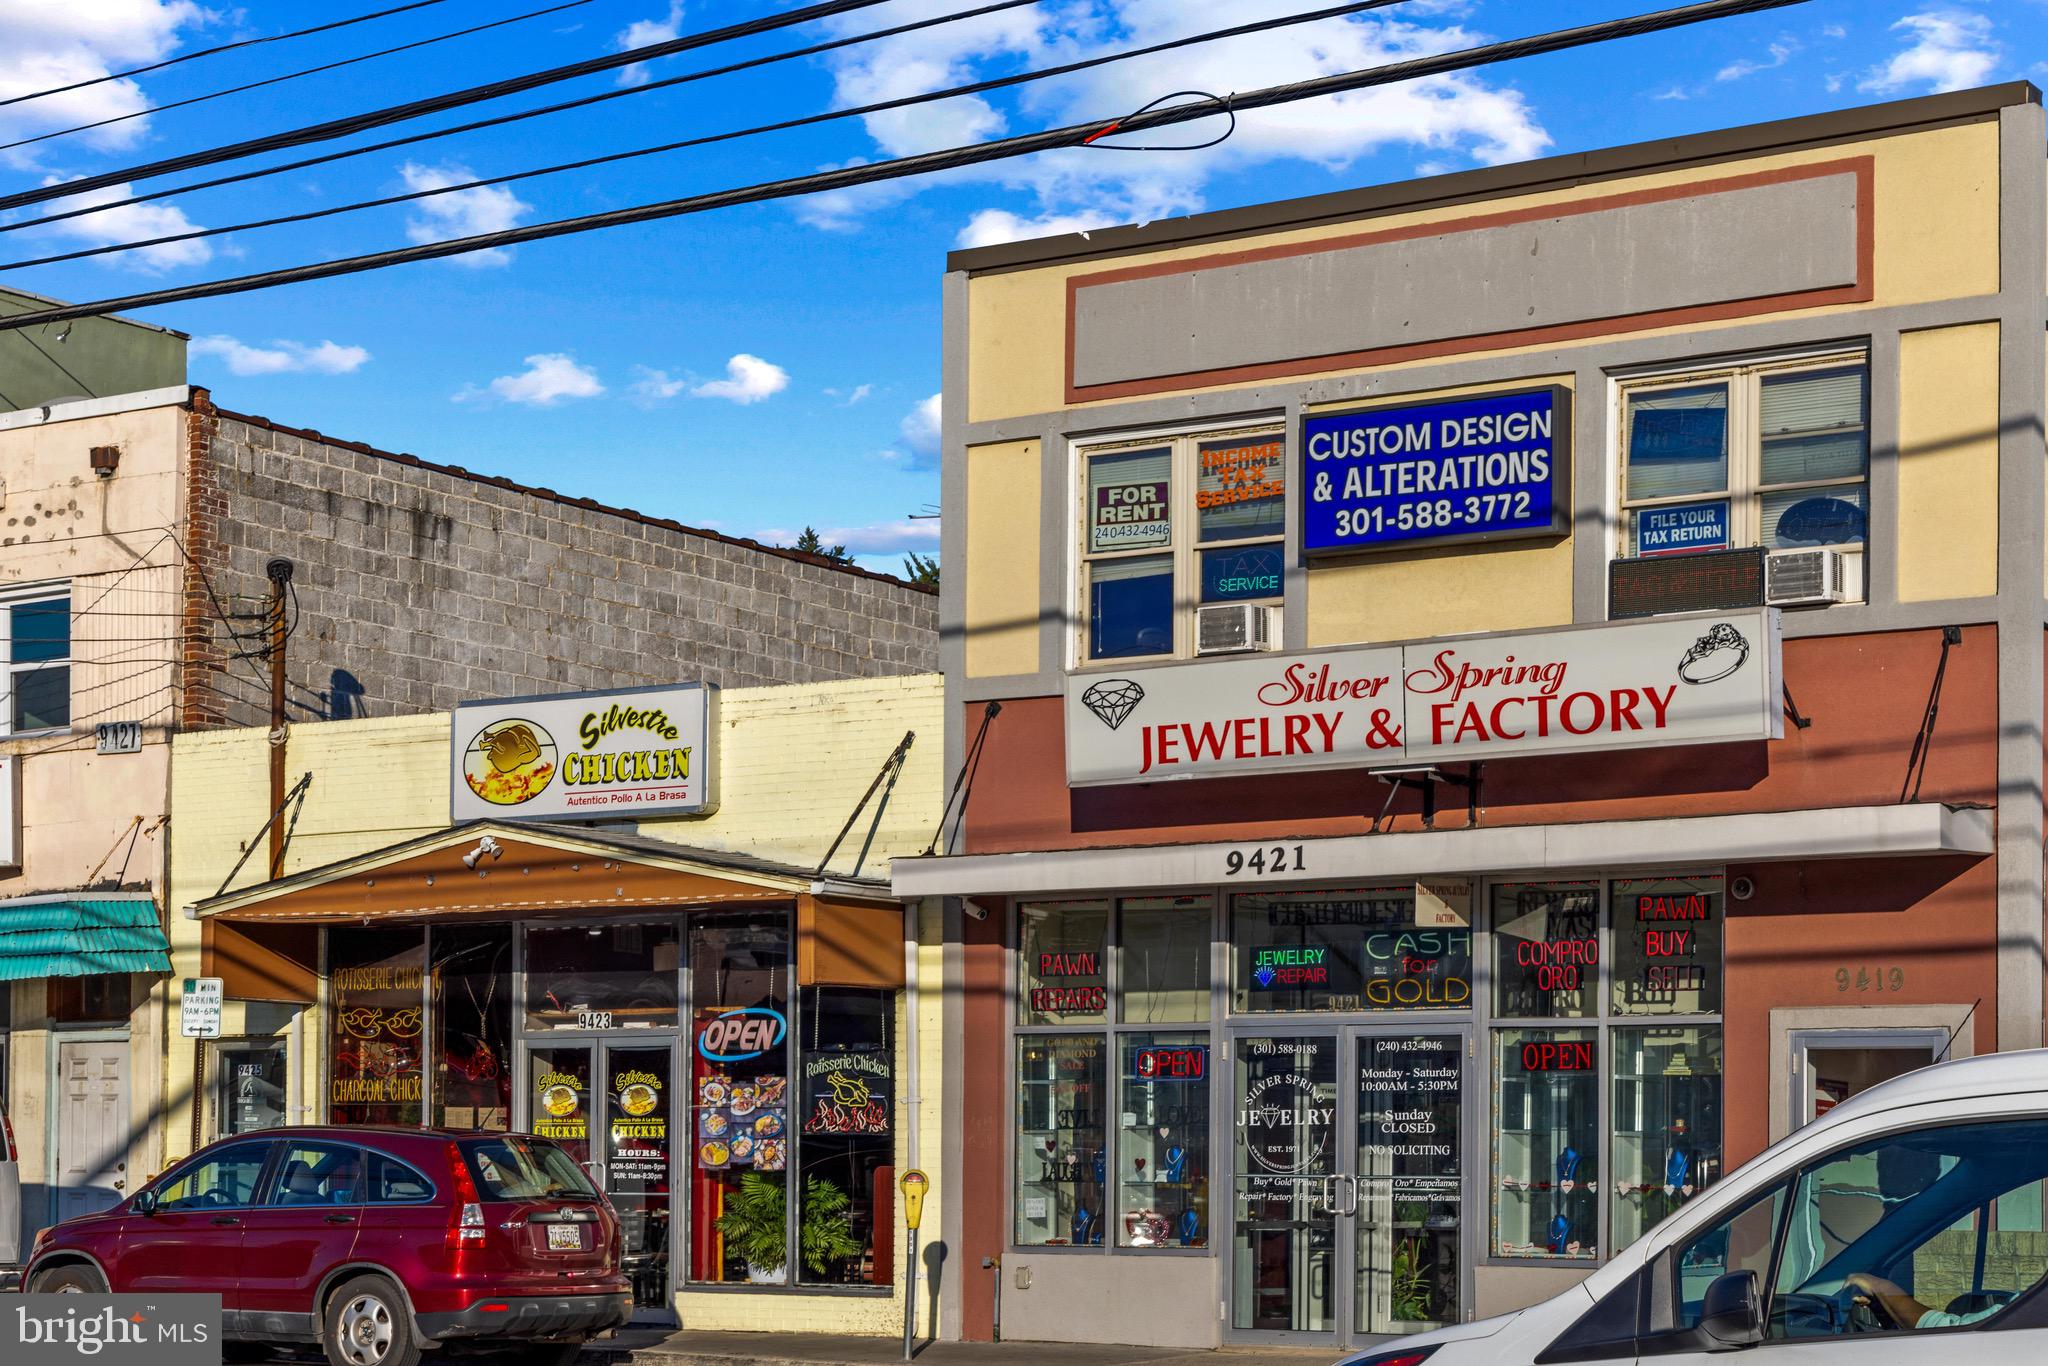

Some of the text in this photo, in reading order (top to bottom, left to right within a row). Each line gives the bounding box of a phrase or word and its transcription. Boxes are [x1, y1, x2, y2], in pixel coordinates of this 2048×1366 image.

[1308, 409, 1552, 462] CUSTOM DESIGN
[1201, 442, 1281, 468] INCOME
[1219, 464, 1266, 485] TAX
[1313, 448, 1549, 502] & ALTERATIONS
[1108, 486, 1157, 505] FOR
[1196, 480, 1285, 509] SERVICE
[1100, 503, 1166, 524] RENT
[1335, 491, 1531, 537] 301-588-3772
[1650, 509, 1715, 528] FILE YOUR
[1643, 524, 1721, 545] TAX RETURN
[1218, 575, 1279, 592] SERVICE
[1257, 650, 1567, 706] Silver Spring
[580, 704, 679, 750] Silvestre
[1139, 684, 1677, 774] JEWELRY & FACTORY
[563, 746, 692, 786] CHICKEN
[566, 790, 687, 806] Autentico Pollo A La Brasa
[1225, 845, 1306, 876] 9421
[1639, 895, 1706, 921] PAWN
[1366, 932, 1471, 960] CASH
[1517, 939, 1599, 967] COMPRO
[1646, 930, 1690, 957] BUY
[1041, 953, 1096, 976] PAWN
[1256, 949, 1325, 967] JEWELRY
[1402, 956, 1438, 975] for
[334, 968, 392, 991] ROTISSERIE
[1276, 967, 1328, 984] REPAIR
[1537, 965, 1578, 991] ORO
[184, 996, 219, 1005] PARKING
[1033, 988, 1106, 1012] REPAIRS
[1366, 978, 1470, 1004] GOLD
[184, 1007, 219, 1015] 9AM-6PM
[579, 1013, 611, 1029] 9423
[704, 1019, 777, 1051] OPEN
[1253, 1044, 1318, 1055] (301) 588-0188
[1376, 1040, 1442, 1053] (240) 432-4946
[1523, 1044, 1591, 1070] OPEN
[239, 1065, 261, 1076] 9425
[806, 1054, 890, 1078] Rotisserie Chicken
[1138, 1051, 1201, 1076] OPEN
[1362, 1068, 1403, 1080] Monday
[1413, 1067, 1458, 1079] Saturday
[333, 1079, 386, 1101] CHARCOAL
[1244, 1073, 1325, 1106] SILVER SPRING
[1361, 1081, 1408, 1091] 10:00AM
[1417, 1080, 1459, 1091] 5:30PM
[1385, 1109, 1432, 1122] Sunday
[534, 1125, 586, 1139] CHICKEN
[612, 1124, 666, 1139] CHICKEN
[1381, 1122, 1436, 1133] CLOSED
[617, 1149, 661, 1157] HOURS:
[1369, 1145, 1451, 1155] NO SOLICITING
[1299, 1193, 1334, 1203] Engravng
